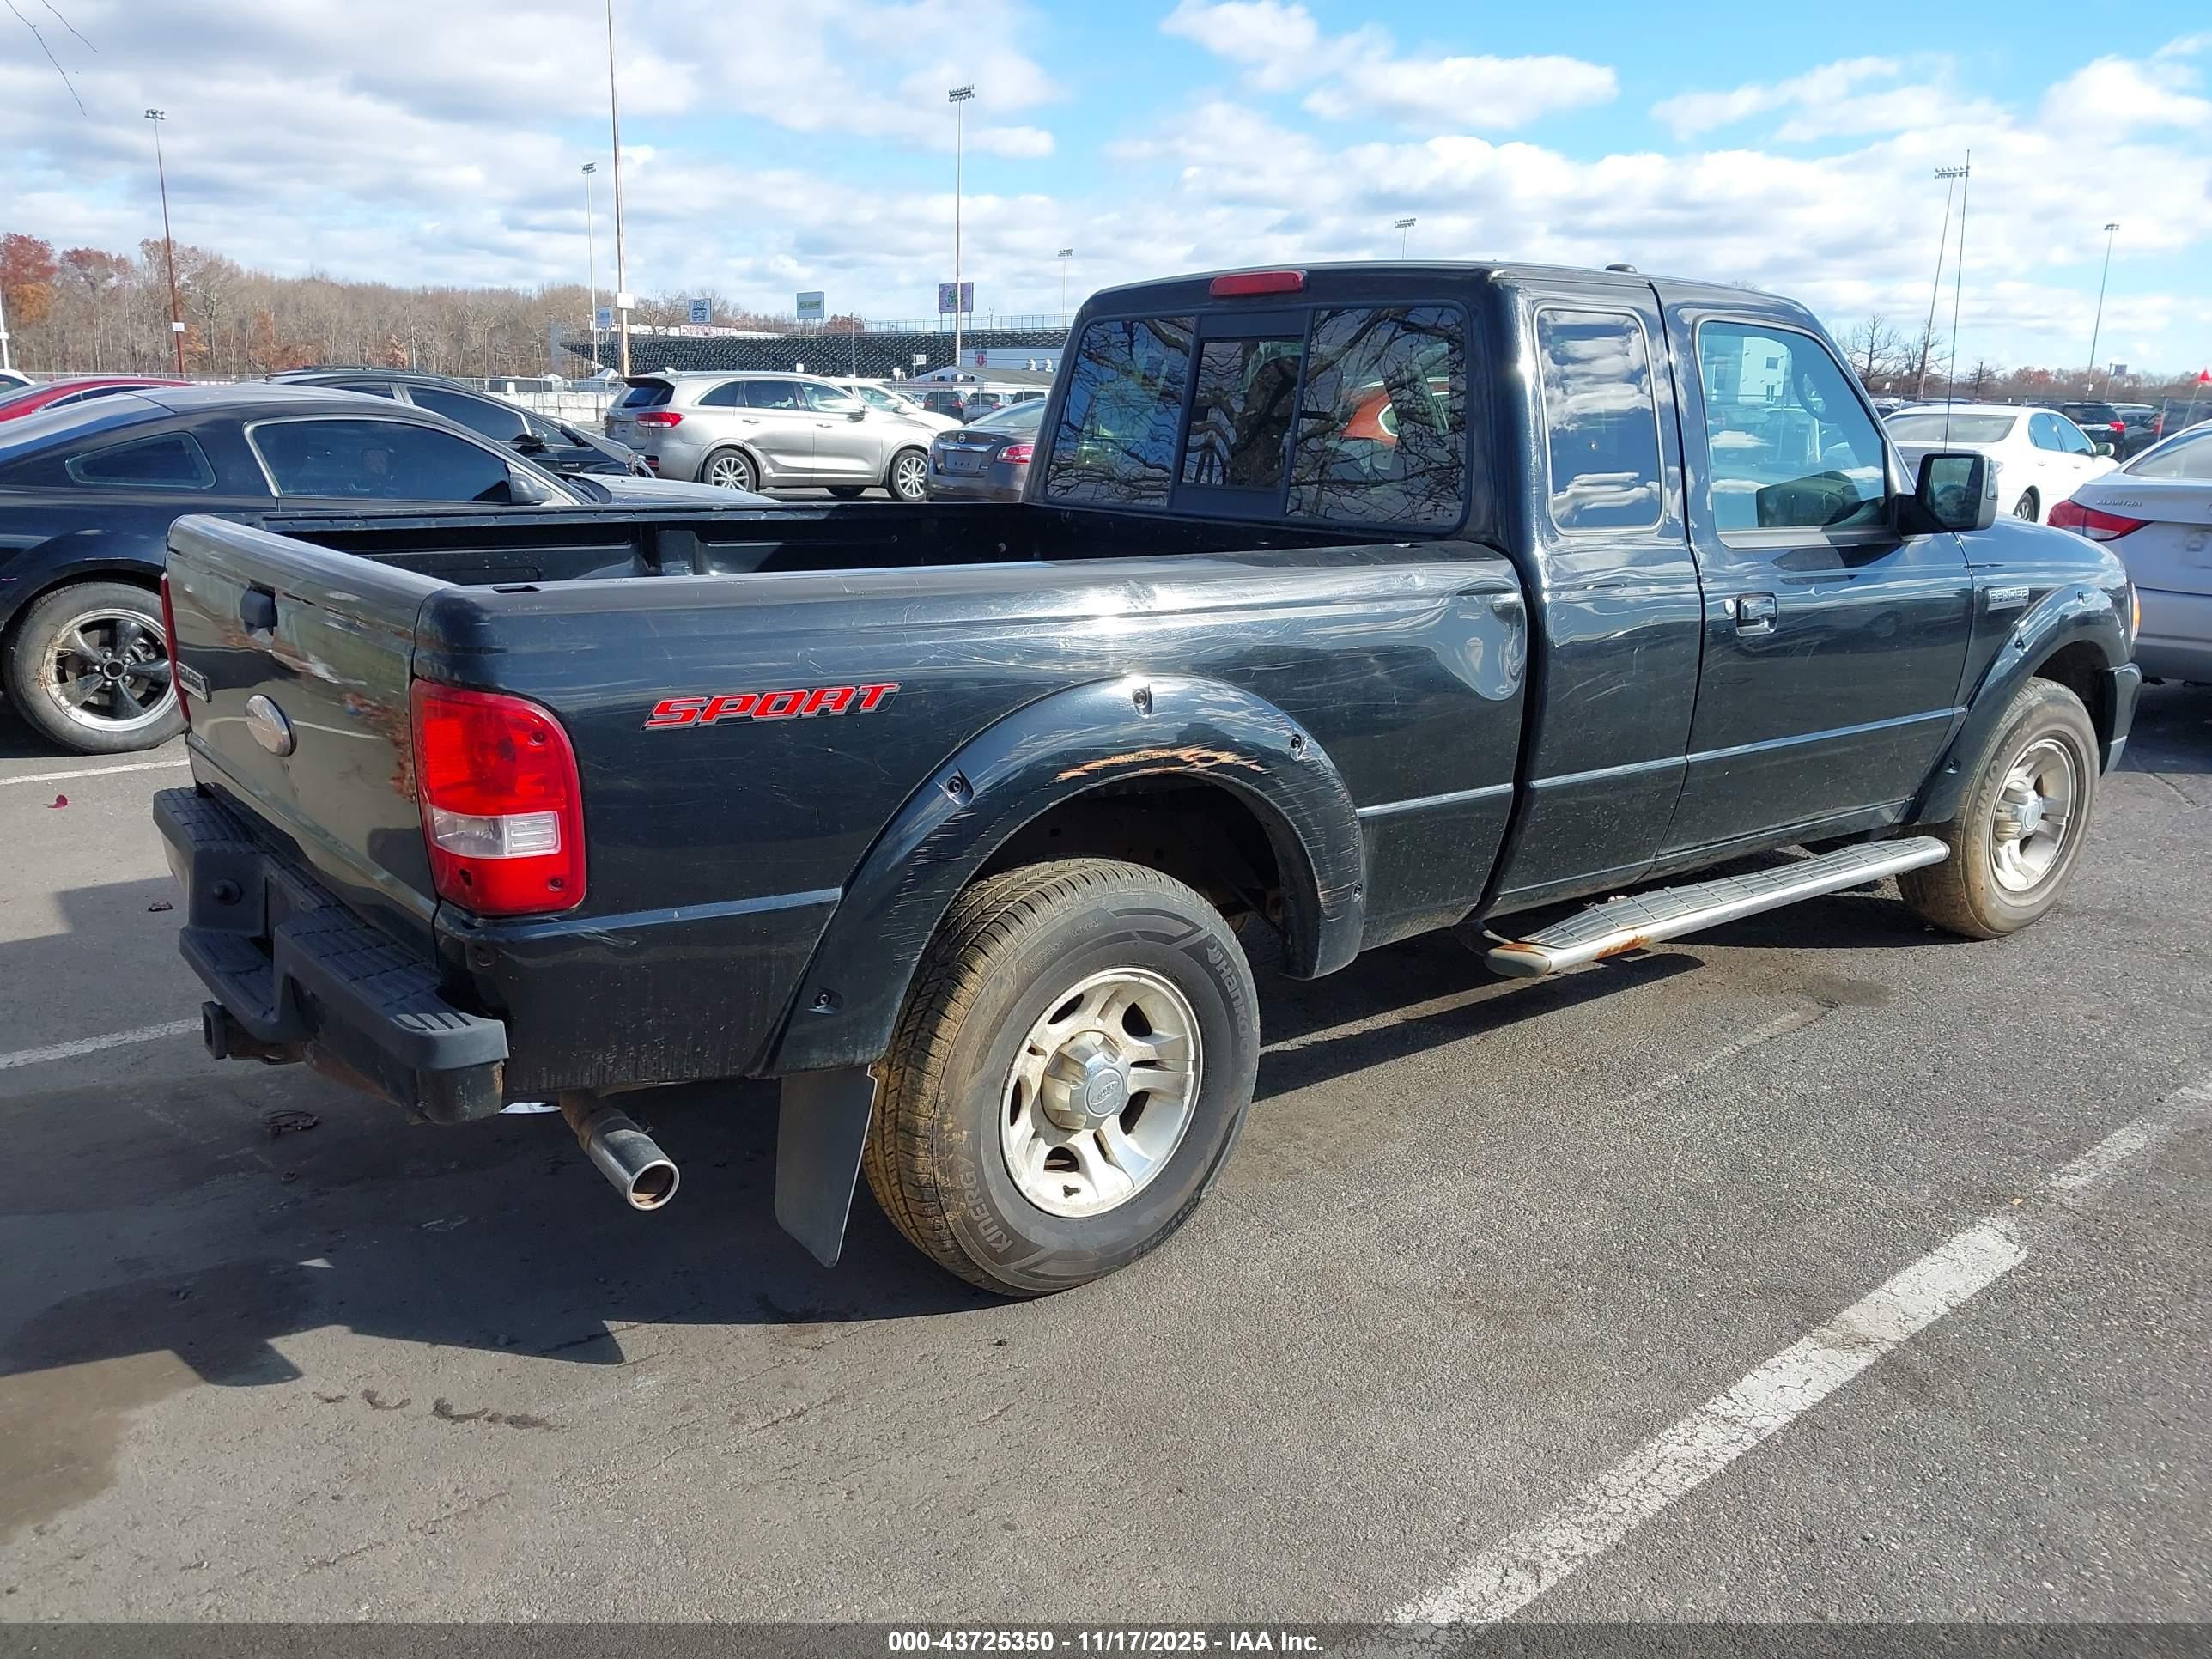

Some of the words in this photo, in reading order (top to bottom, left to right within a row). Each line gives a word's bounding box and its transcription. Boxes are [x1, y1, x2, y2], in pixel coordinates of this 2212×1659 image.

[1990, 587, 2028, 601] RANGER
[642, 684, 902, 730] SPORT
[957, 1153, 1014, 1254] KINERGY
